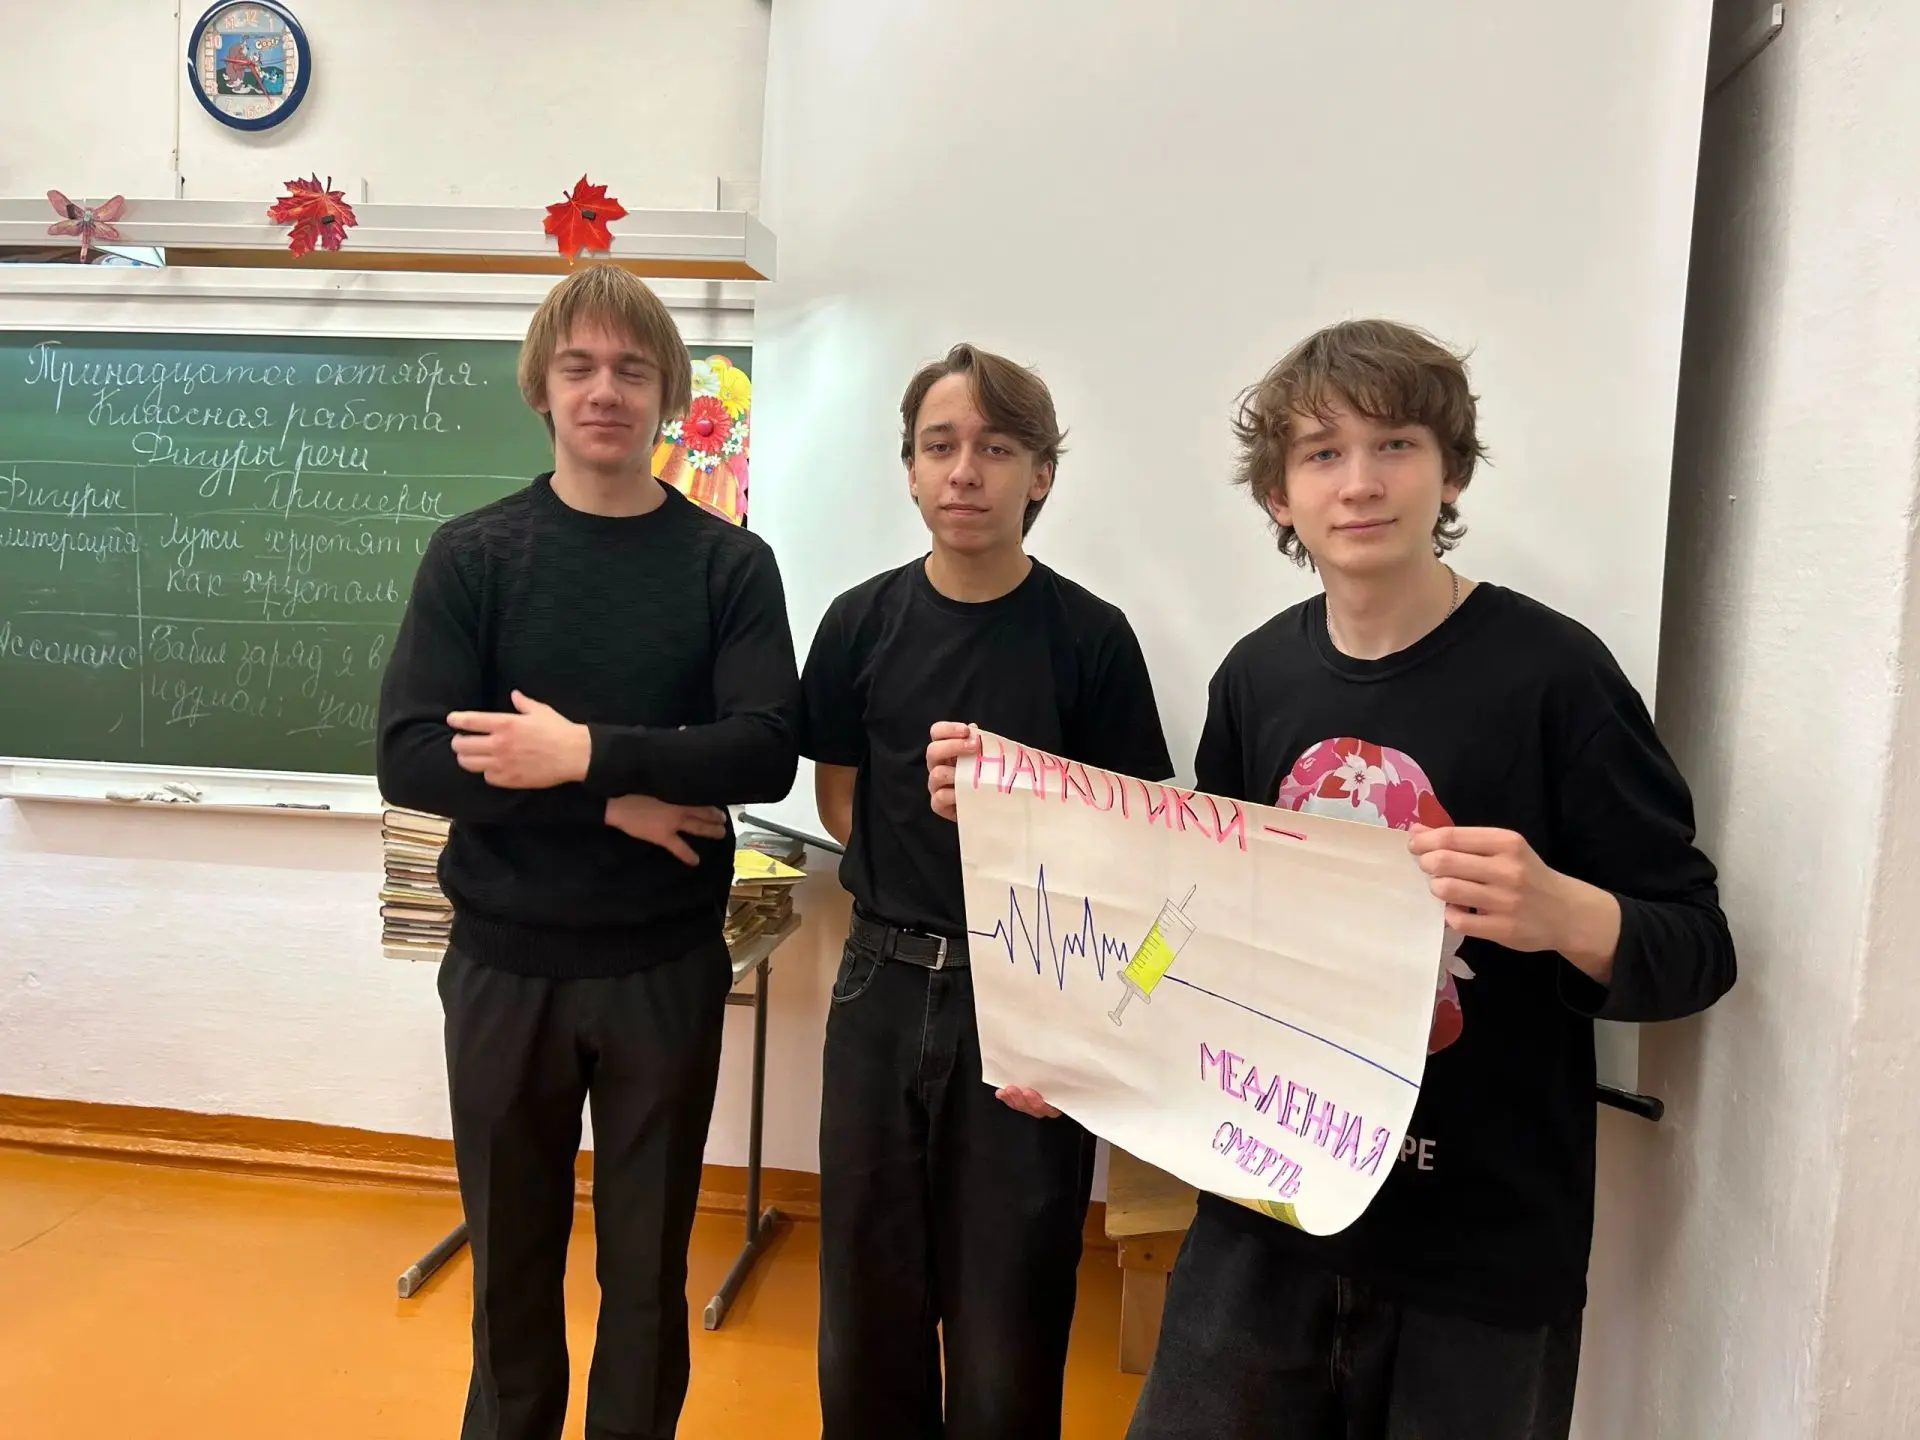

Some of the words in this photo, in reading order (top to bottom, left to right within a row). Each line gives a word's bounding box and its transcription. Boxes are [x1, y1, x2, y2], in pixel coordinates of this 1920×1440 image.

[315, 351, 489, 413] октября.
[88, 388, 274, 430] Классная
[280, 398, 462, 450] работа.
[0, 464, 127, 518] Фигуры
[132, 429, 284, 497] Фигуры
[253, 471, 456, 523] Примеры
[264, 526, 400, 574] хрустят
[150, 625, 226, 664] Забил
[236, 638, 322, 698] заряд
[1199, 1041, 1391, 1176] МЕДЛЕННАЯ
[1212, 1120, 1304, 1198] СМЕРТЬ
